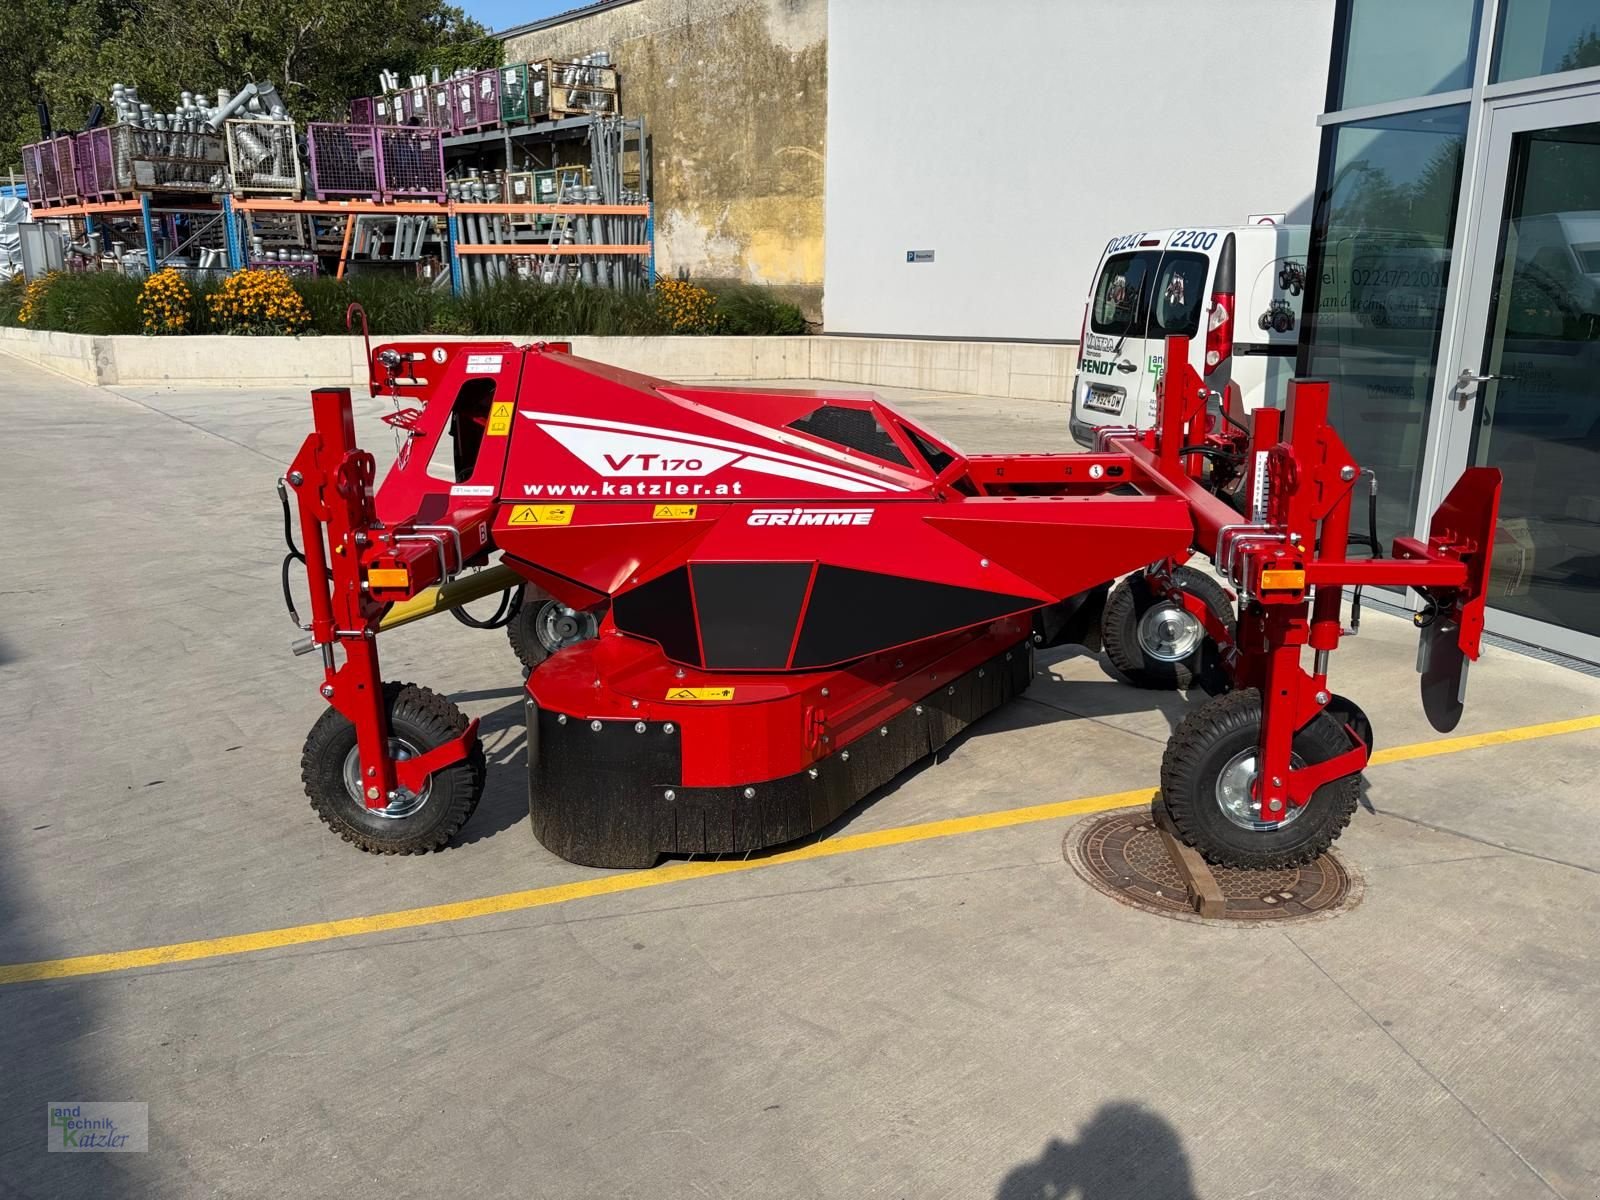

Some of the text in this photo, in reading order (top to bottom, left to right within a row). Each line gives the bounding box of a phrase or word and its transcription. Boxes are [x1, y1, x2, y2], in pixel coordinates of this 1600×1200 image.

[1107, 230, 1218, 254] 02247 2200
[1081, 358, 1117, 376] FENDT
[523, 481, 742, 496] www.katzler.at
